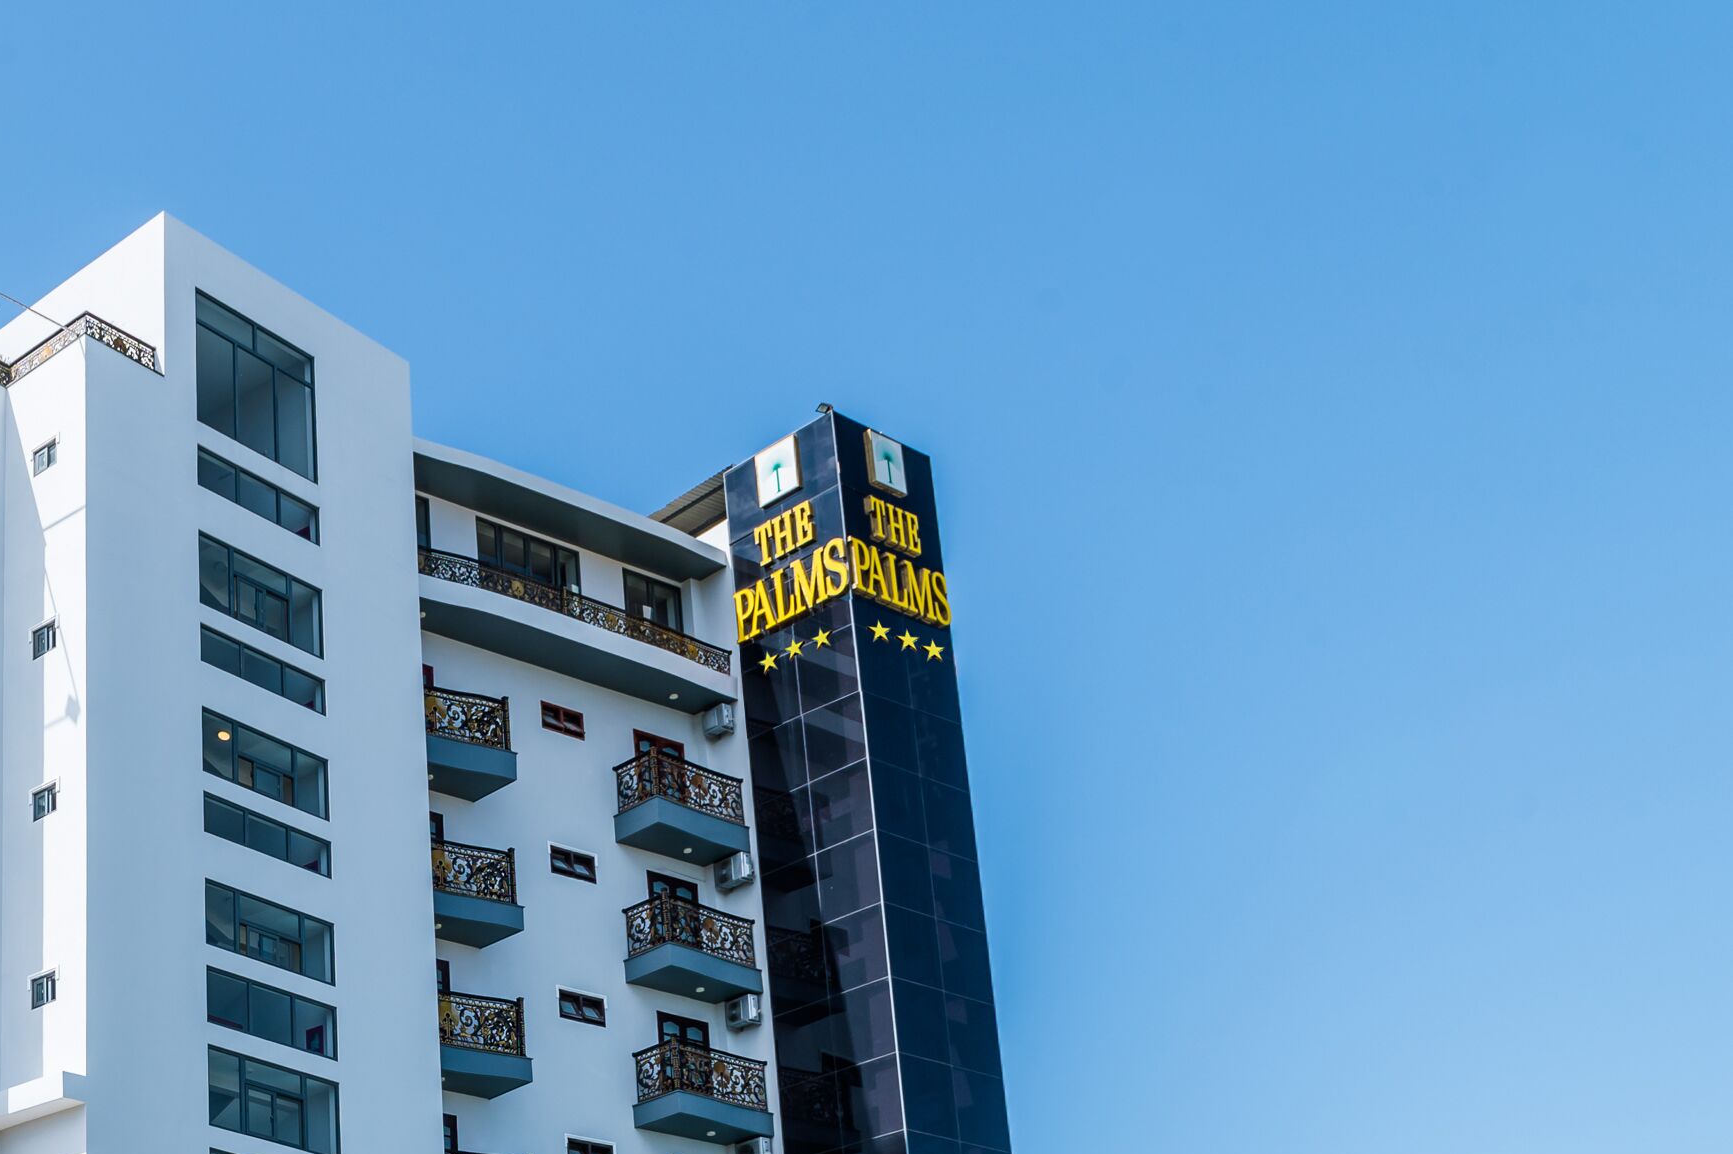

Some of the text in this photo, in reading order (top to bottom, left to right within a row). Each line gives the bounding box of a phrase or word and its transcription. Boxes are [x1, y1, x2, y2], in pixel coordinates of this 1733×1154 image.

[754, 500, 813, 567] THE
[865, 495, 922, 556] THE
[733, 538, 849, 644] PALMS
[848, 536, 951, 628] PALMS
